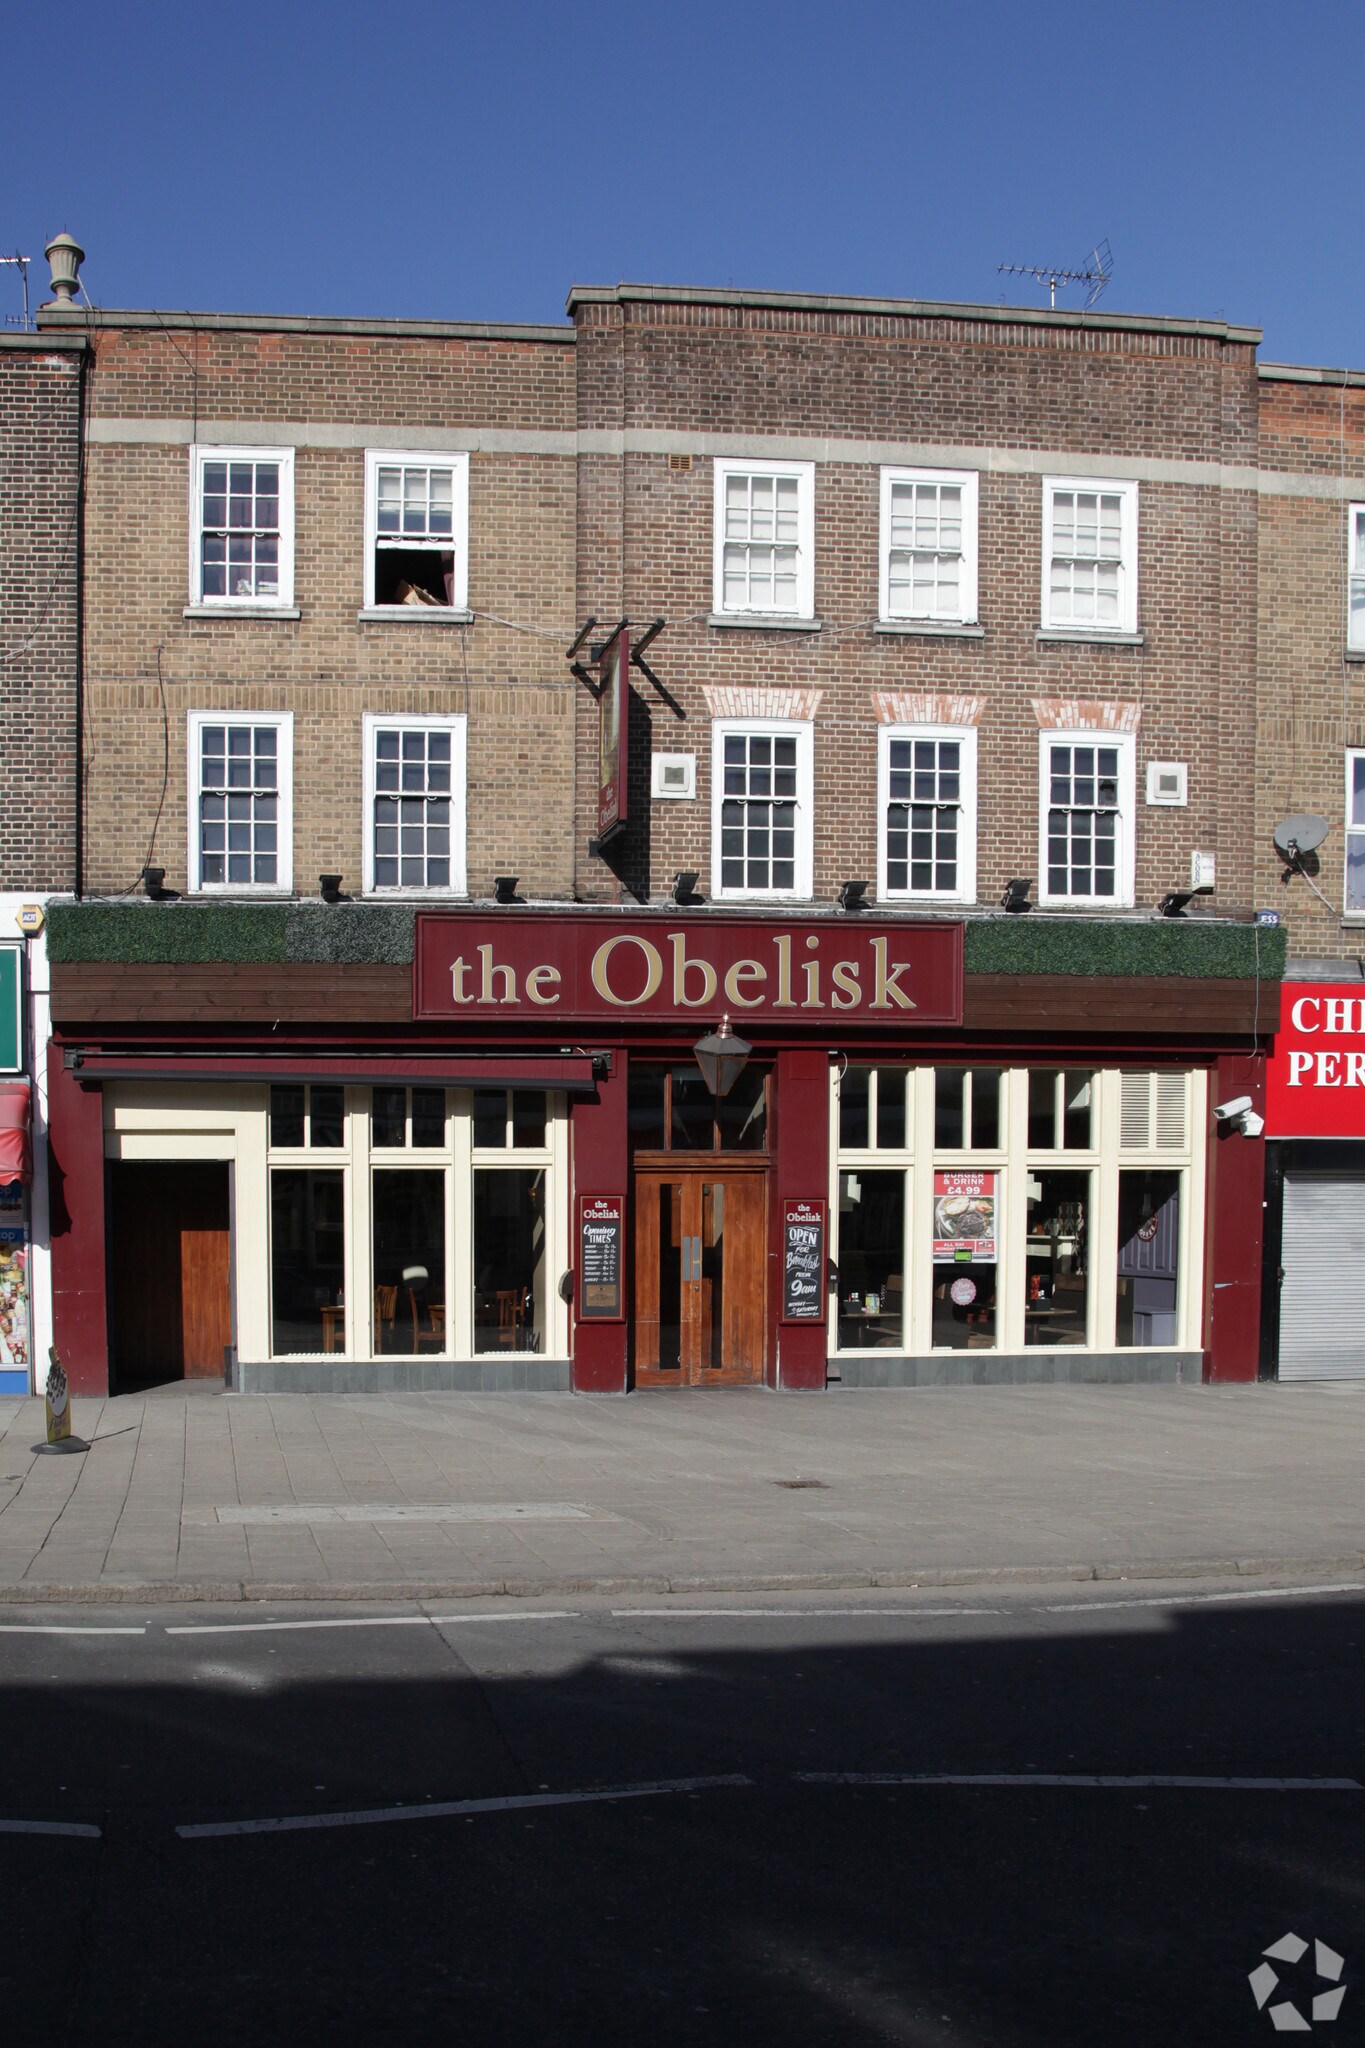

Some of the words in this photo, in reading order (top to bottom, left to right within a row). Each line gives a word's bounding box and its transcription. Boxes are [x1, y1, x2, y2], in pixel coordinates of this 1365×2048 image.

[449, 944, 562, 1005] the
[590, 932, 917, 1010] Obelisk
[947, 1186, 981, 1195] £4.99
[595, 1200, 608, 1209] the
[797, 1203, 810, 1212] the
[583, 1209, 620, 1219] Obelisk
[786, 1212, 822, 1222] Obelisk
[583, 1224, 616, 1237] Opening
[589, 1234, 612, 1244] TIMES
[789, 1228, 817, 1245] OPEN
[791, 1279, 817, 1297] 9am
